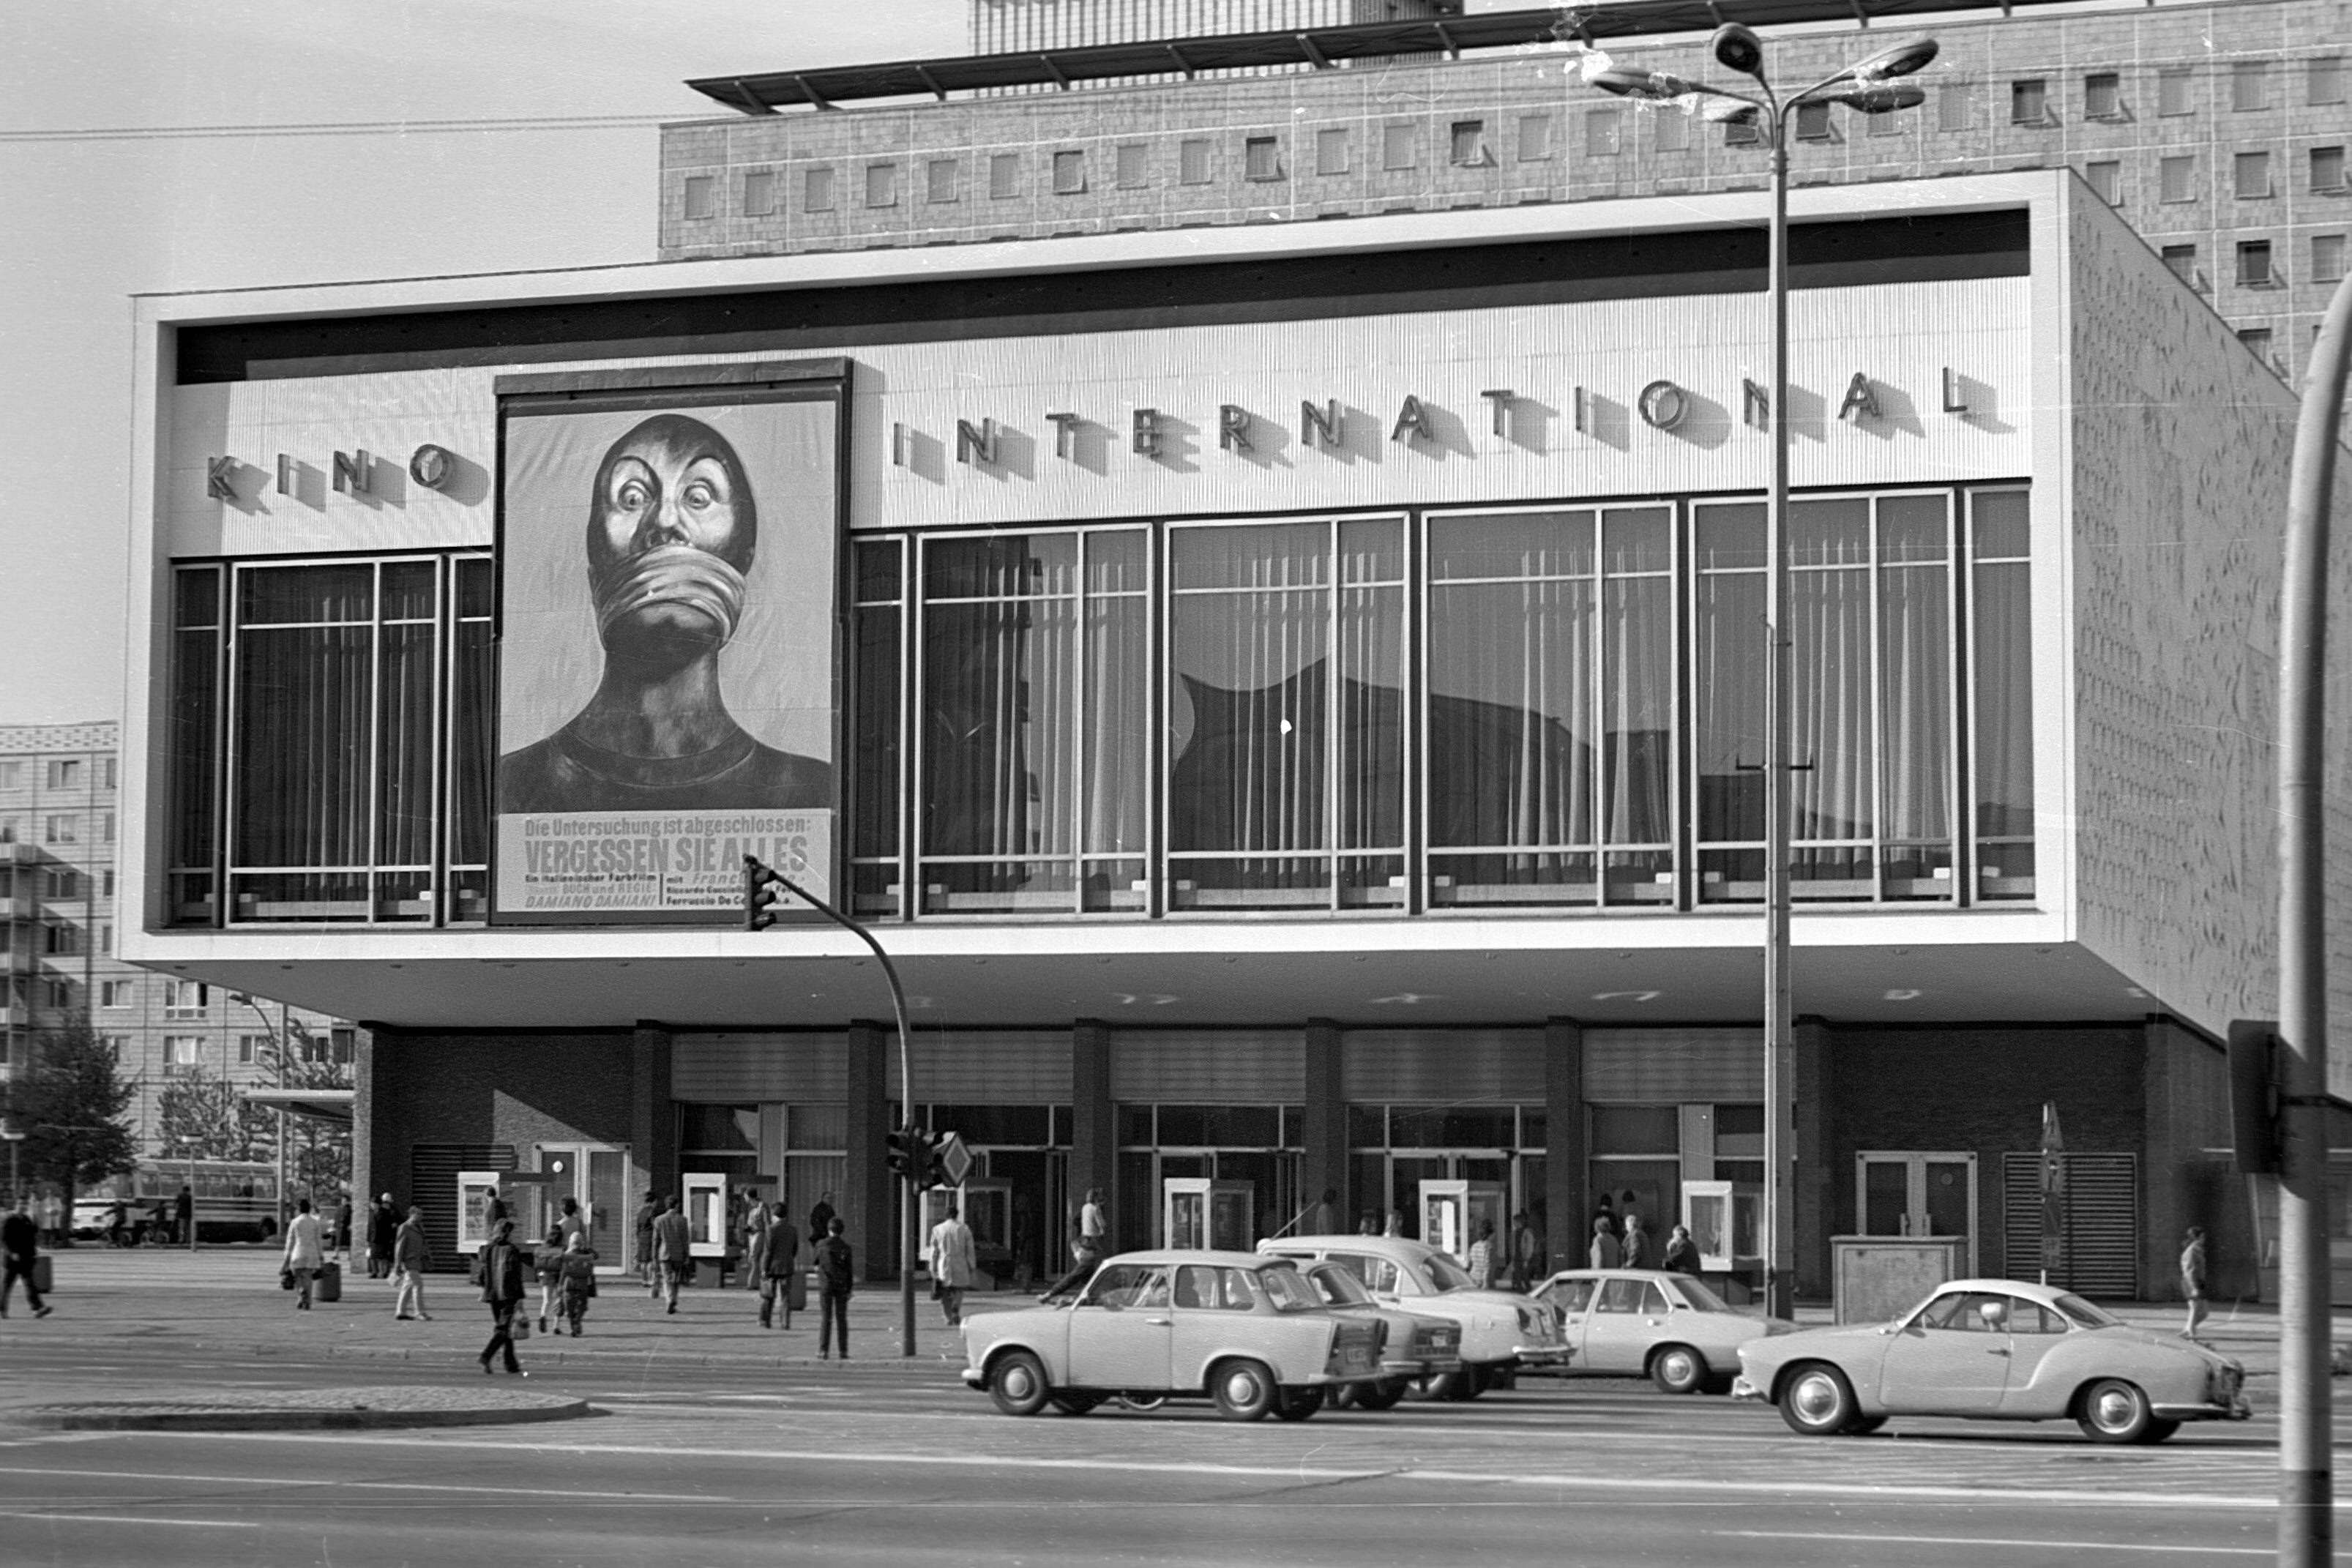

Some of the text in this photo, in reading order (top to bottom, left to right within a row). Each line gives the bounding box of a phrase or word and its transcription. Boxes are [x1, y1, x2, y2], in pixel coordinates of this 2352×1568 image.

[207, 366, 1968, 499] KINO INTERNATIONAL
[525, 815, 811, 837] Die Untersuchung ist abgeschlossen:
[525, 838, 669, 873] VERGESSEN
[675, 837, 717, 873] SIE
[562, 884, 590, 895] BUCH
[591, 883, 615, 895] und
[525, 895, 657, 908] DAMIANO DAMIANI
